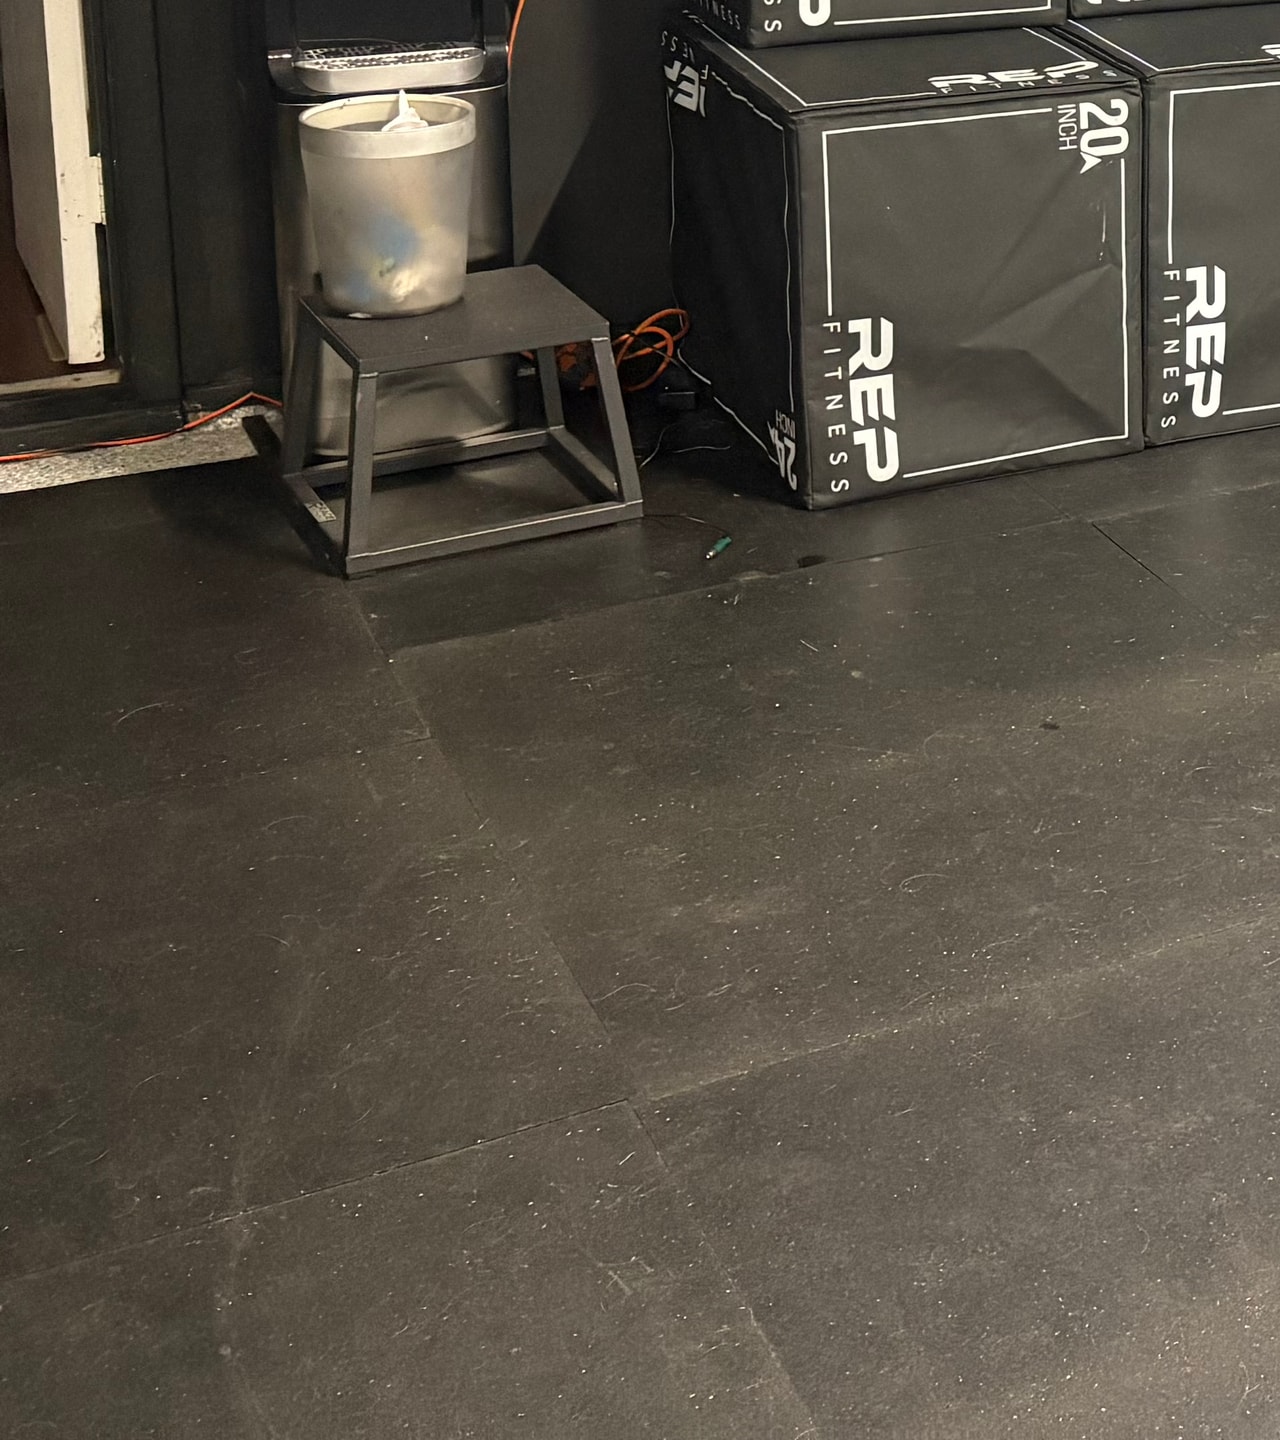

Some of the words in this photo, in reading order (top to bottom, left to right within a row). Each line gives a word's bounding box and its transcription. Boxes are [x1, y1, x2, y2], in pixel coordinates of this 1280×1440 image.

[928, 60, 1099, 88] REP
[940, 69, 1118, 94] FITNESS
[1057, 103, 1078, 151] INCH
[1079, 98, 1129, 157] 20
[1161, 269, 1181, 428] FITNESS
[1185, 264, 1227, 418] REP
[822, 321, 850, 492] FITNESS
[848, 317, 900, 482] REP
[772, 427, 798, 491] 24
